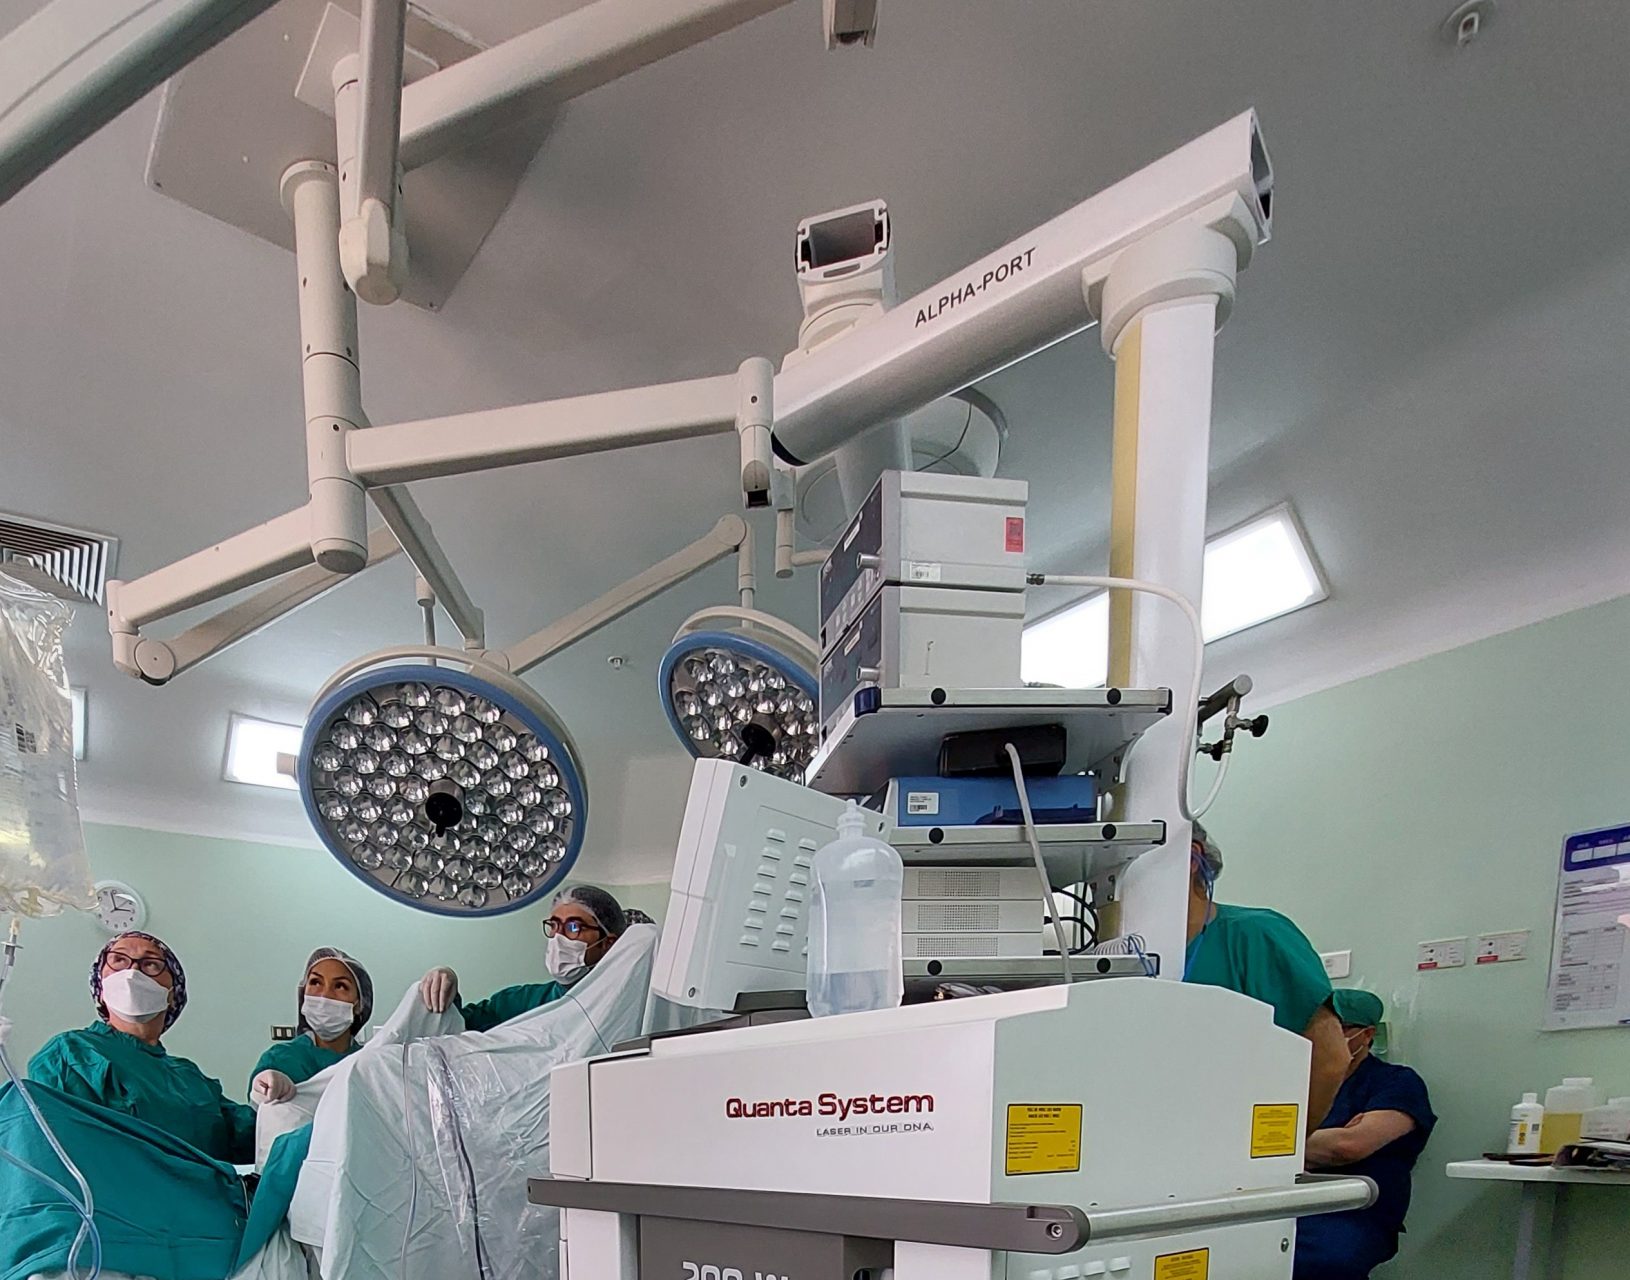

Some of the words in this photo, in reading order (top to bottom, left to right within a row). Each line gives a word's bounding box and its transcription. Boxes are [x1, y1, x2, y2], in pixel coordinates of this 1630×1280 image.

[915, 247, 1036, 328] ALPHA-PORT
[726, 1098, 812, 1118] Quanta
[818, 1093, 934, 1121] System
[816, 1127, 851, 1136] LASER
[856, 1126, 868, 1134] IN
[872, 1124, 898, 1133] OUR
